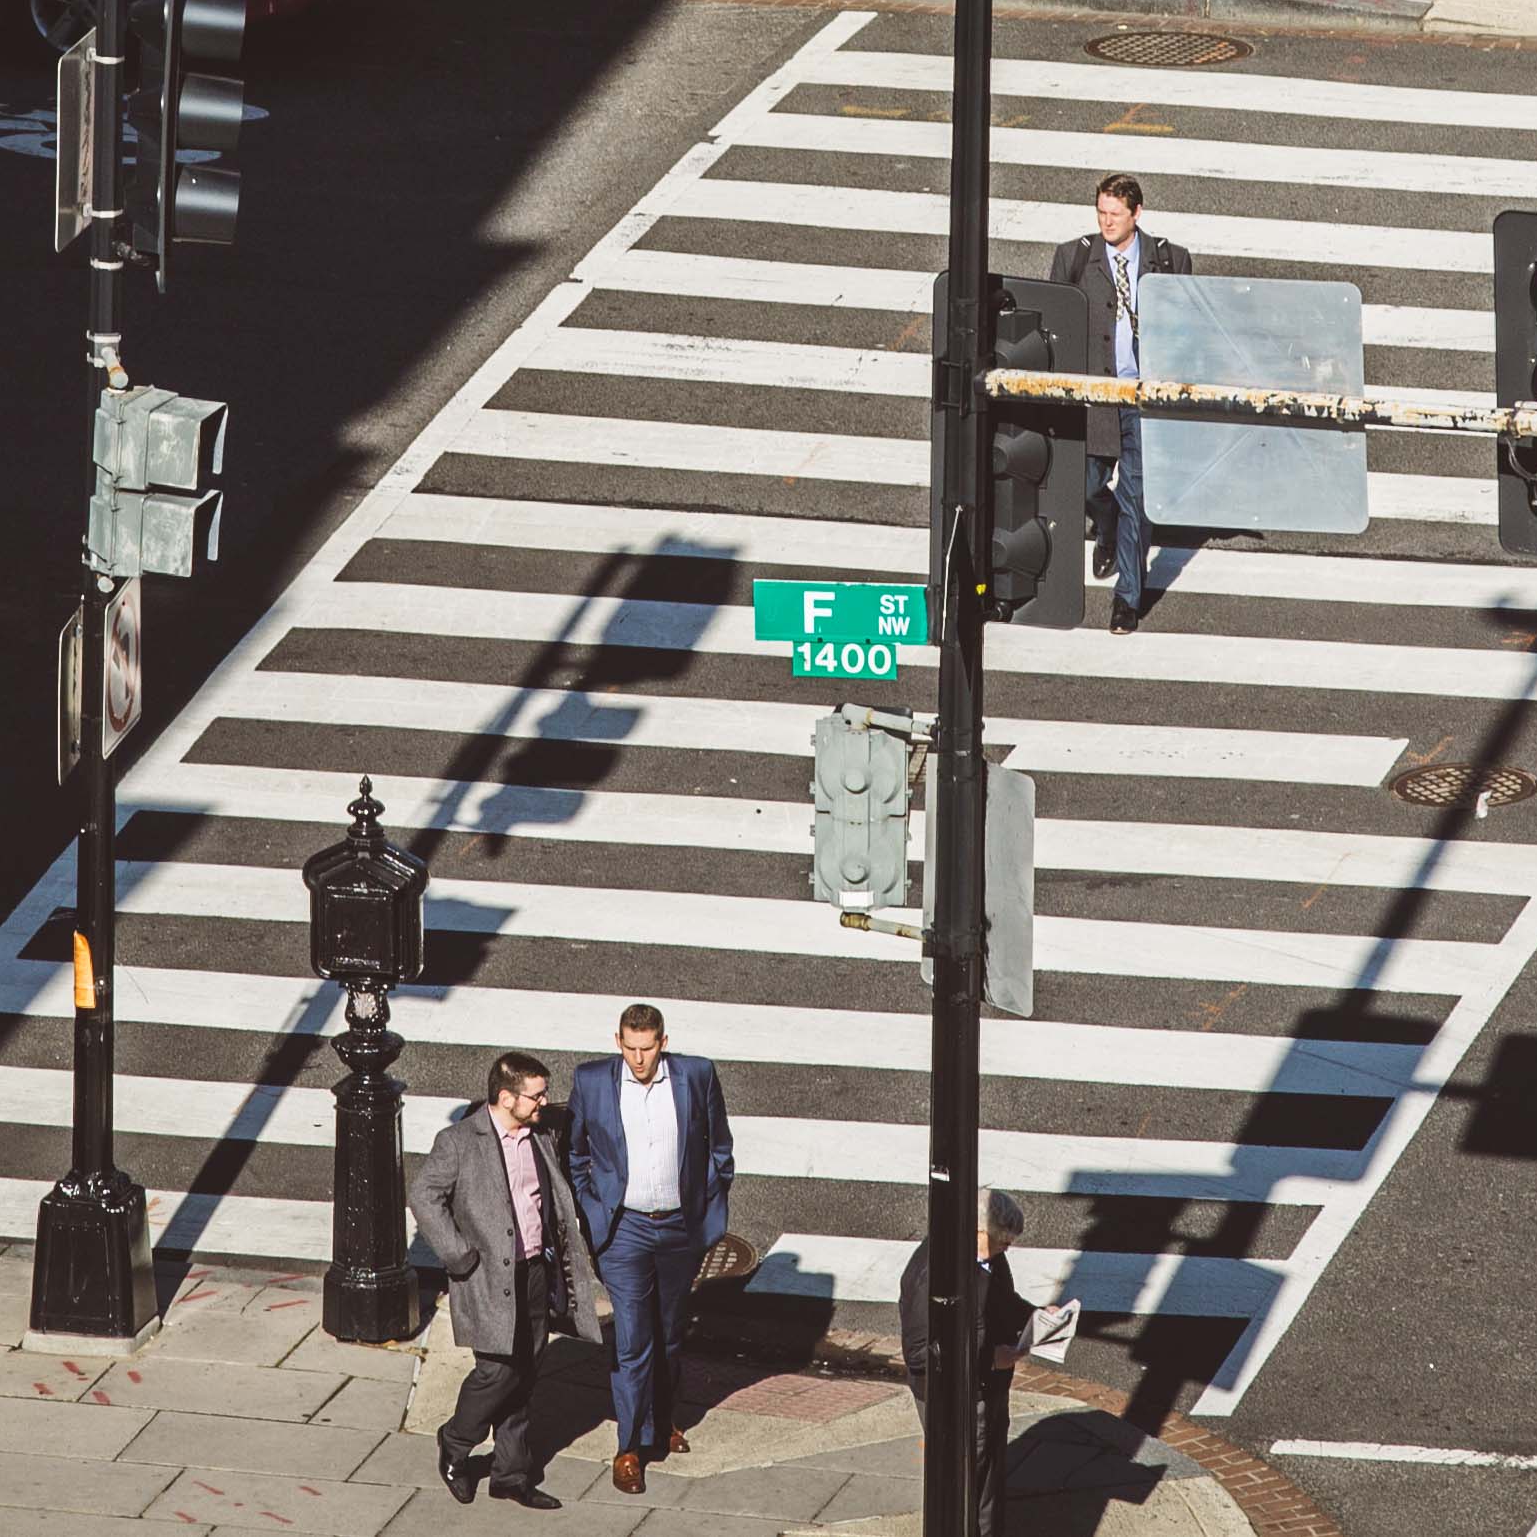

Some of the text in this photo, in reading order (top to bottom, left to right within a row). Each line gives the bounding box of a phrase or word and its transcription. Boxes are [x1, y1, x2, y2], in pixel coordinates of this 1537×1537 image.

[803, 591, 909, 634] F ST
[878, 617, 910, 635] NW
[797, 642, 892, 675] 1400
